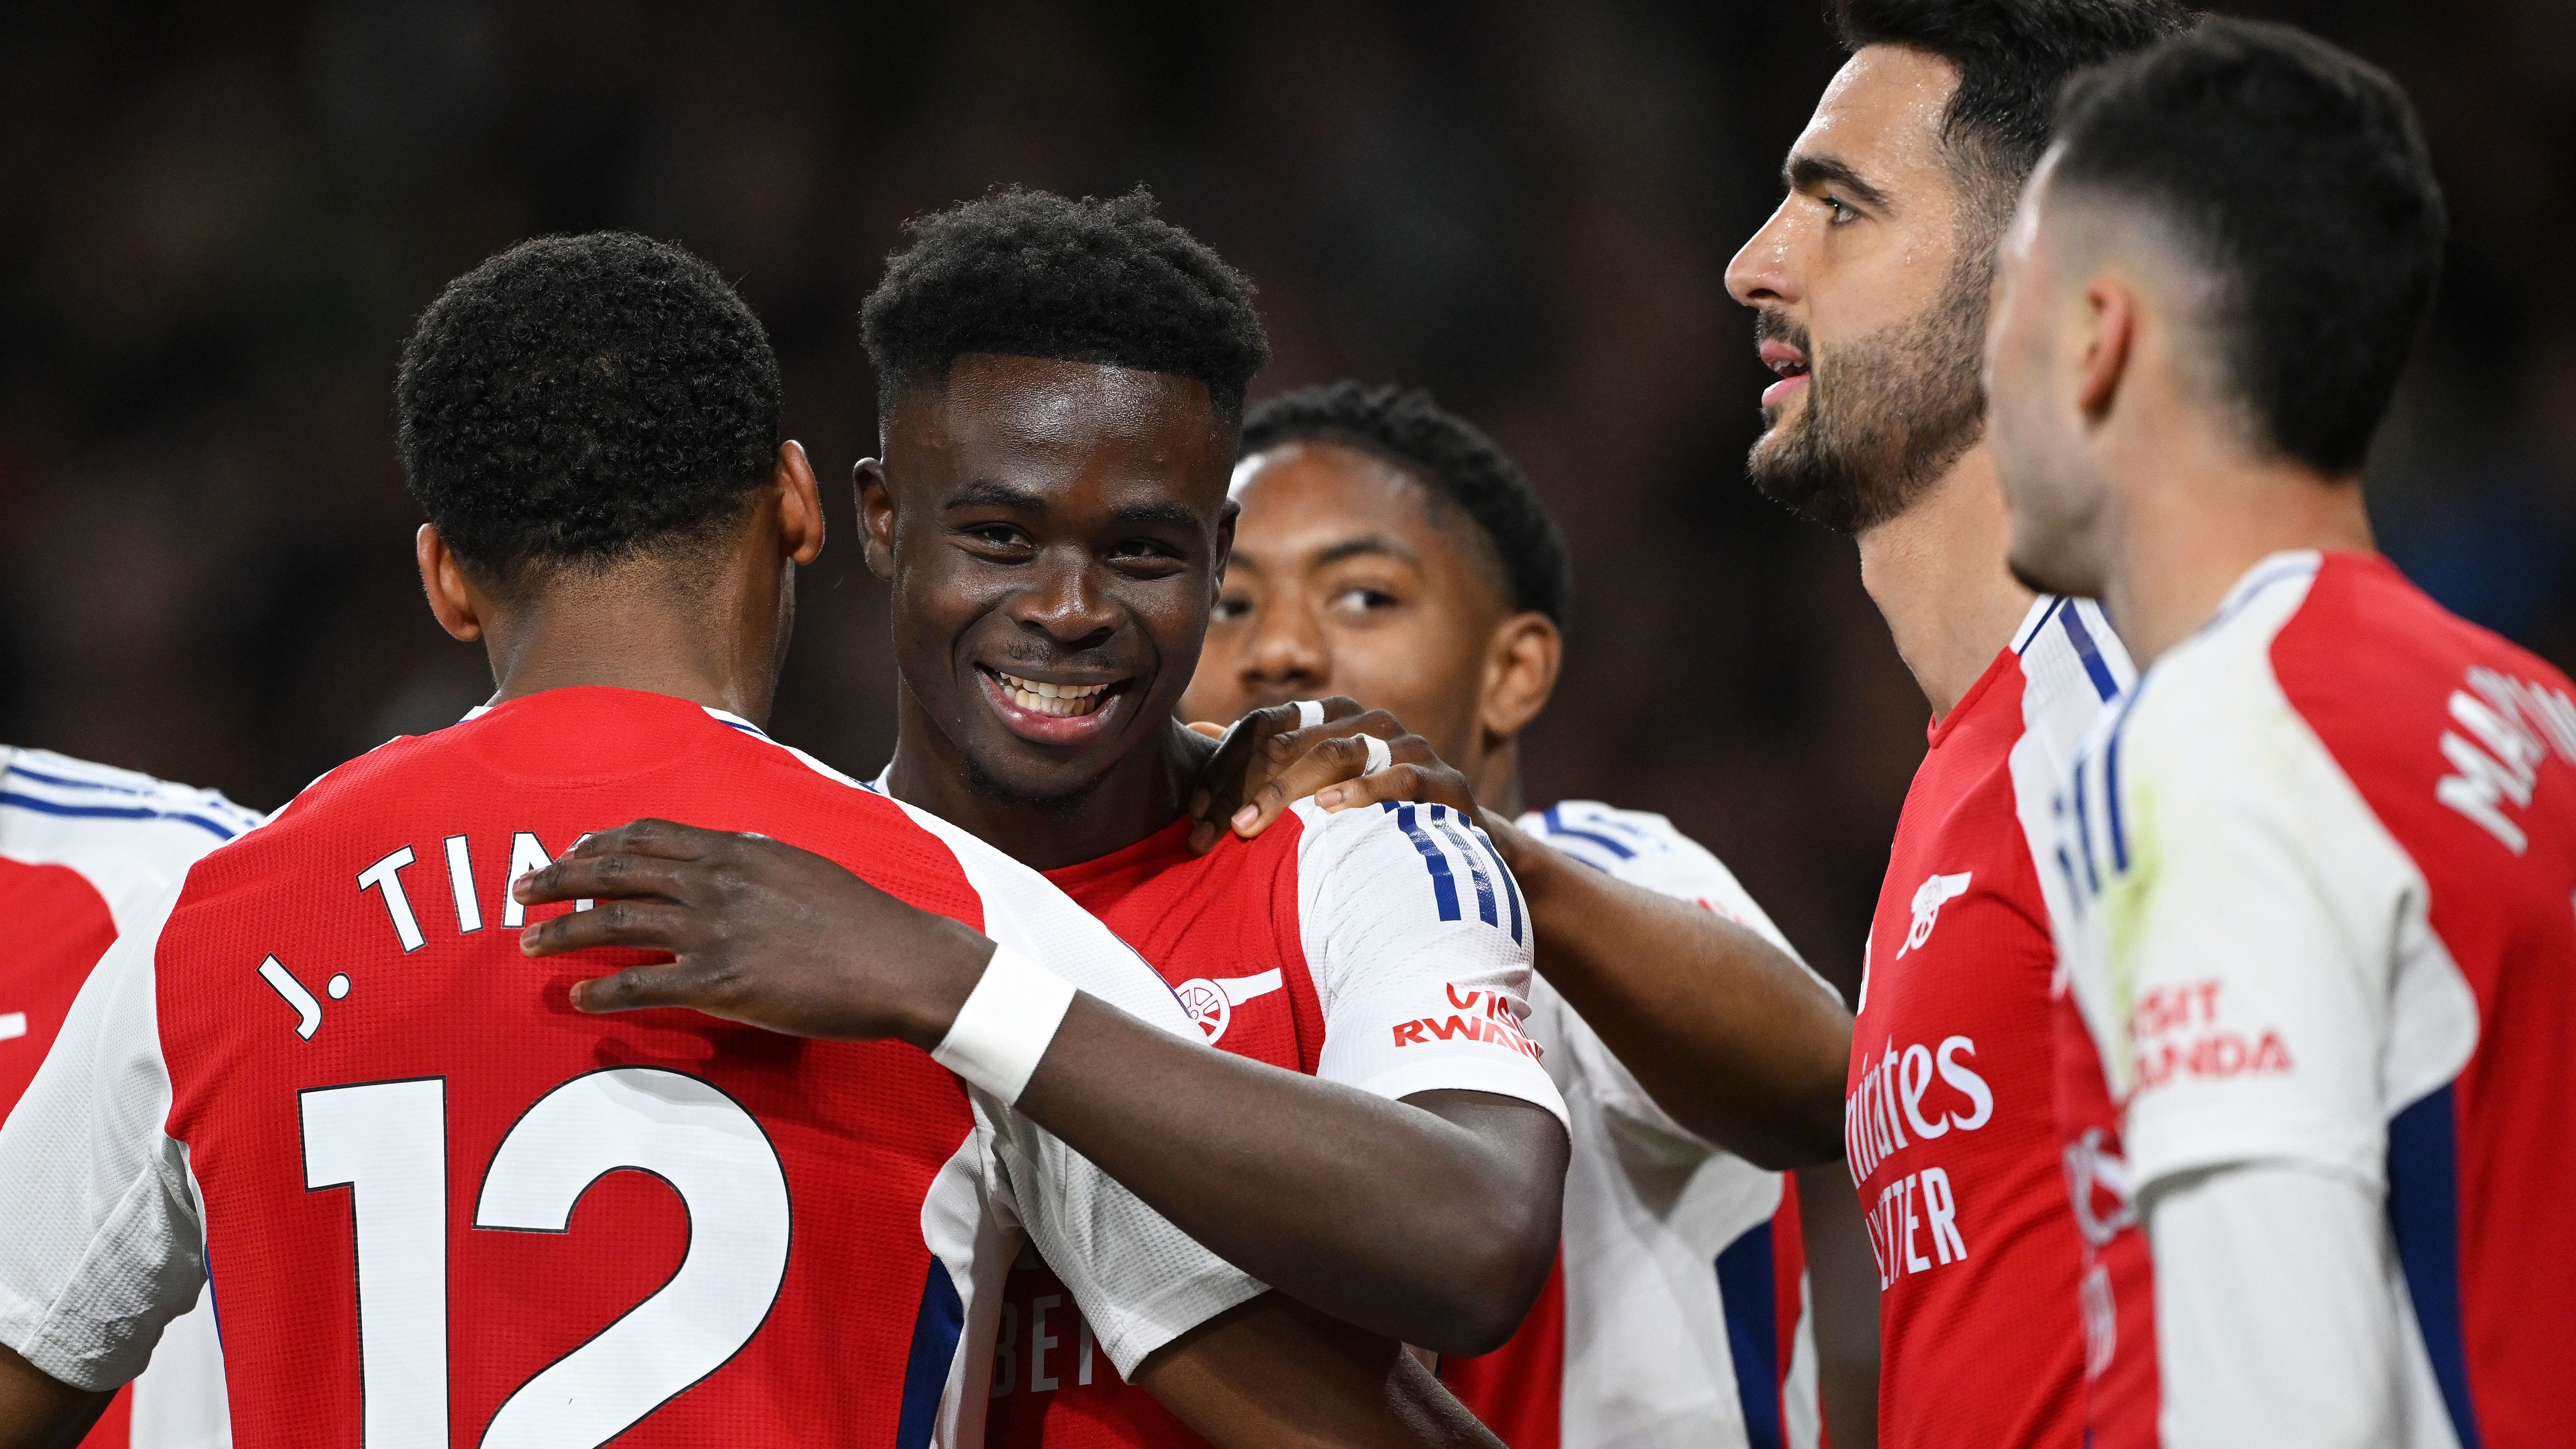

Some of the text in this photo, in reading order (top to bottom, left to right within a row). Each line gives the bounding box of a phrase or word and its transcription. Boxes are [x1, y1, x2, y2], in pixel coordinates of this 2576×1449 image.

[256, 952, 352, 1043] J.
[296, 1065, 793, 1449] 12
[992, 1294, 1093, 1398] BET
